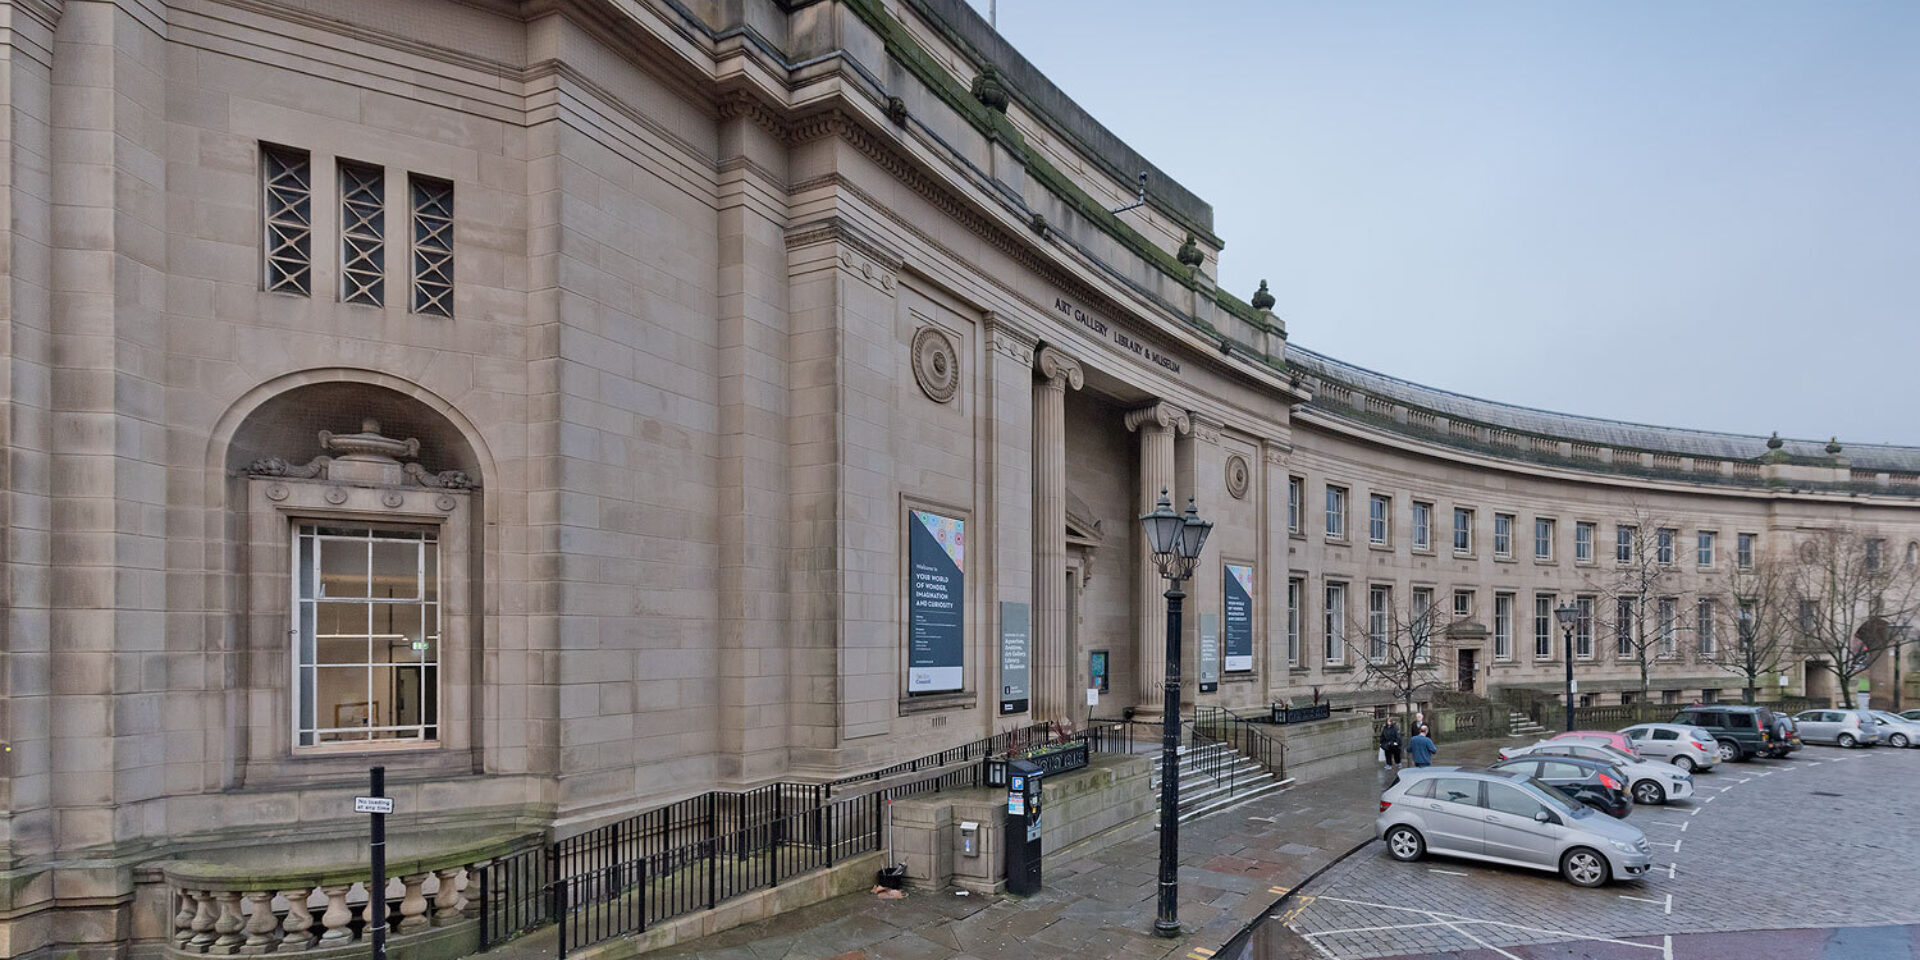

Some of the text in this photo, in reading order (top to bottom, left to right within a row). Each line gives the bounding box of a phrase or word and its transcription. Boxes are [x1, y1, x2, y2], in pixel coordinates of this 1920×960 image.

[1054, 297, 1181, 374] ART GALLERY LIBRARY & MUSEUM
[916, 573, 949, 583] YOUR WORLD
[916, 591, 948, 600] IMAGINATION
